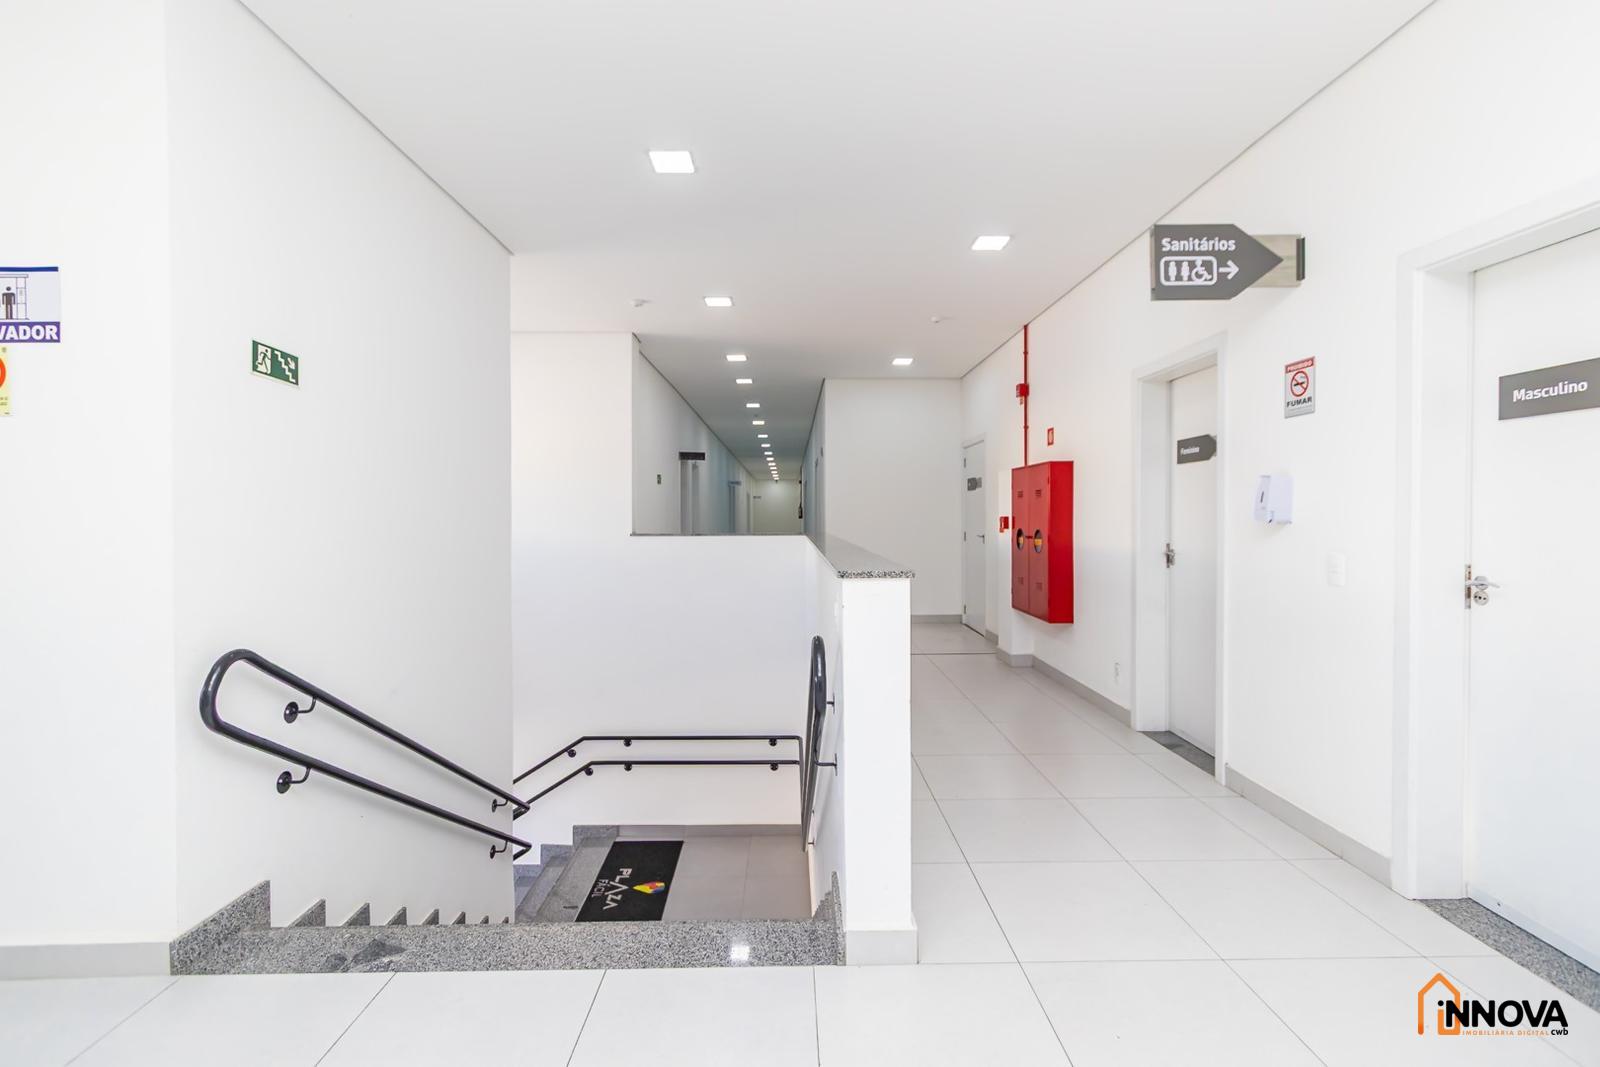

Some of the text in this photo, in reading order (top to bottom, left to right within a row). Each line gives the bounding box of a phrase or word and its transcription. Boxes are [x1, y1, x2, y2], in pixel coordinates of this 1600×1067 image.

[1161, 237, 1236, 251] Sanitários
[1512, 381, 1588, 402] Masculino
[1286, 397, 1312, 407] FUMAR
[603, 868, 632, 910] PLAZA
